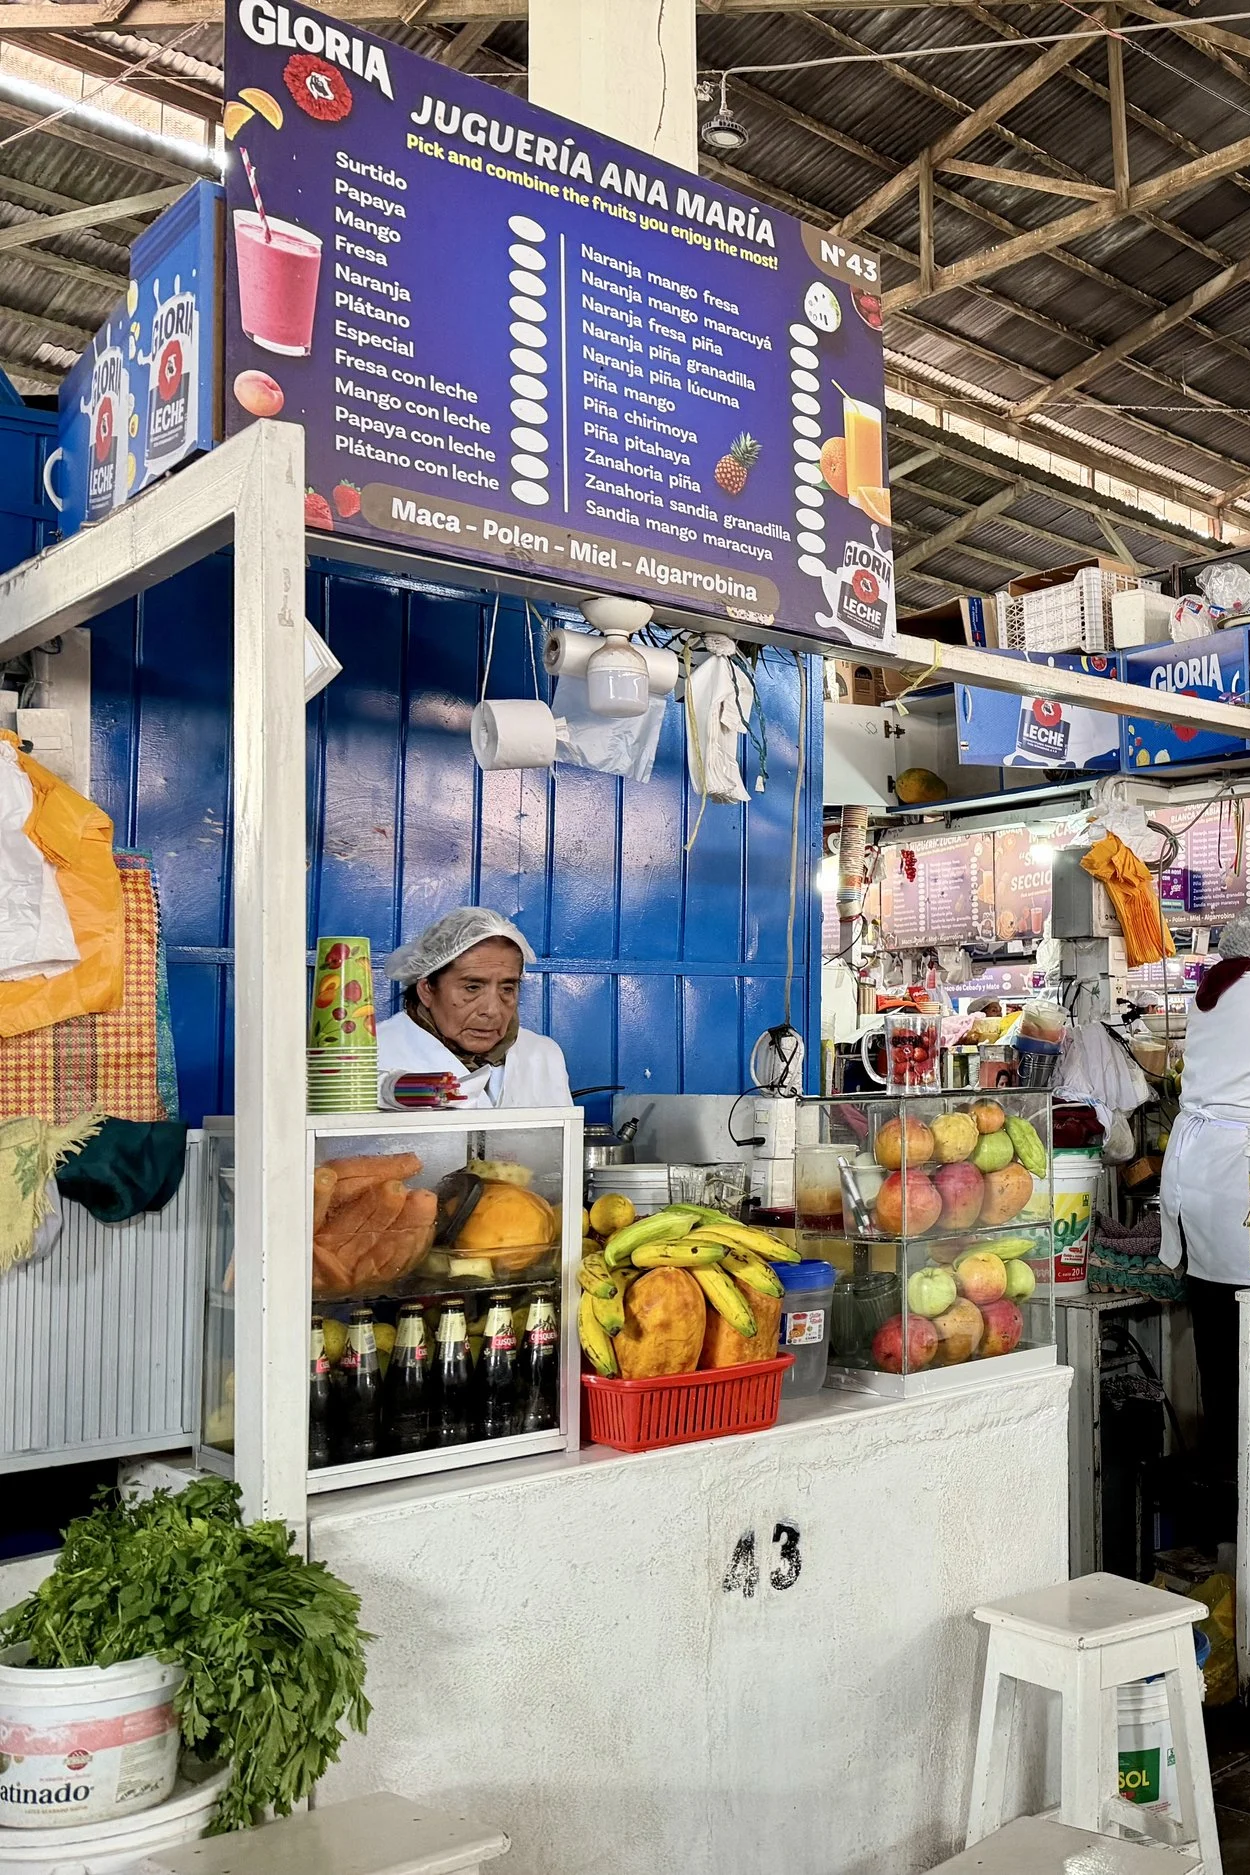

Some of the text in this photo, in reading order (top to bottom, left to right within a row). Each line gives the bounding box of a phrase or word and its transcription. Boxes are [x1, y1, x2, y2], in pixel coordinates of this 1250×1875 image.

[239, 0, 394, 100] GLORIA
[336, 152, 407, 190] Surtido
[410, 95, 775, 248] JUGUERÍA ANA MARÍA
[336, 179, 406, 218] Papaya
[406, 133, 779, 270] Pick and combine the fruits you enjoy the most!
[336, 207, 401, 243] Mango
[336, 236, 388, 266] Fresa
[336, 263, 411, 302] Naranja
[581, 244, 739, 315] Naranja mango fresa
[336, 292, 410, 328] Plátano
[581, 269, 772, 351] Naranja mango maracuyá
[582, 294, 723, 357] Naranja fresa piña
[336, 320, 414, 357] Especial
[583, 320, 755, 392] Naranja piña granadilla
[336, 348, 477, 403] Fresa con leche
[583, 345, 739, 409] Naranja piña lúcuma
[583, 370, 675, 413] Piña mango
[150, 398, 184, 434] LECHE
[336, 377, 490, 434] Mango con leche
[584, 396, 697, 444] Piña chirimoya
[336, 406, 495, 462] Papaya con leche
[584, 422, 690, 466] Piña pitahaya
[89, 464, 114, 495] LECHE
[336, 435, 499, 490] Plátano con leche
[585, 448, 701, 493] Zanahoria piña
[585, 473, 791, 542] Zanahoria sandia granadilla
[392, 498, 758, 602] Maca Polen Miel Algarrobina
[586, 500, 773, 561] Sandia mango maracuya
[844, 545, 892, 590] GLORIA
[843, 596, 881, 624] LECHE
[1151, 654, 1223, 692] GLORIA
[1022, 724, 1065, 748] LECHE
[1011, 871, 1052, 891] SECCIO
[1071, 1268, 1080, 1277] 20
[0, 1781, 90, 1804] atinado
